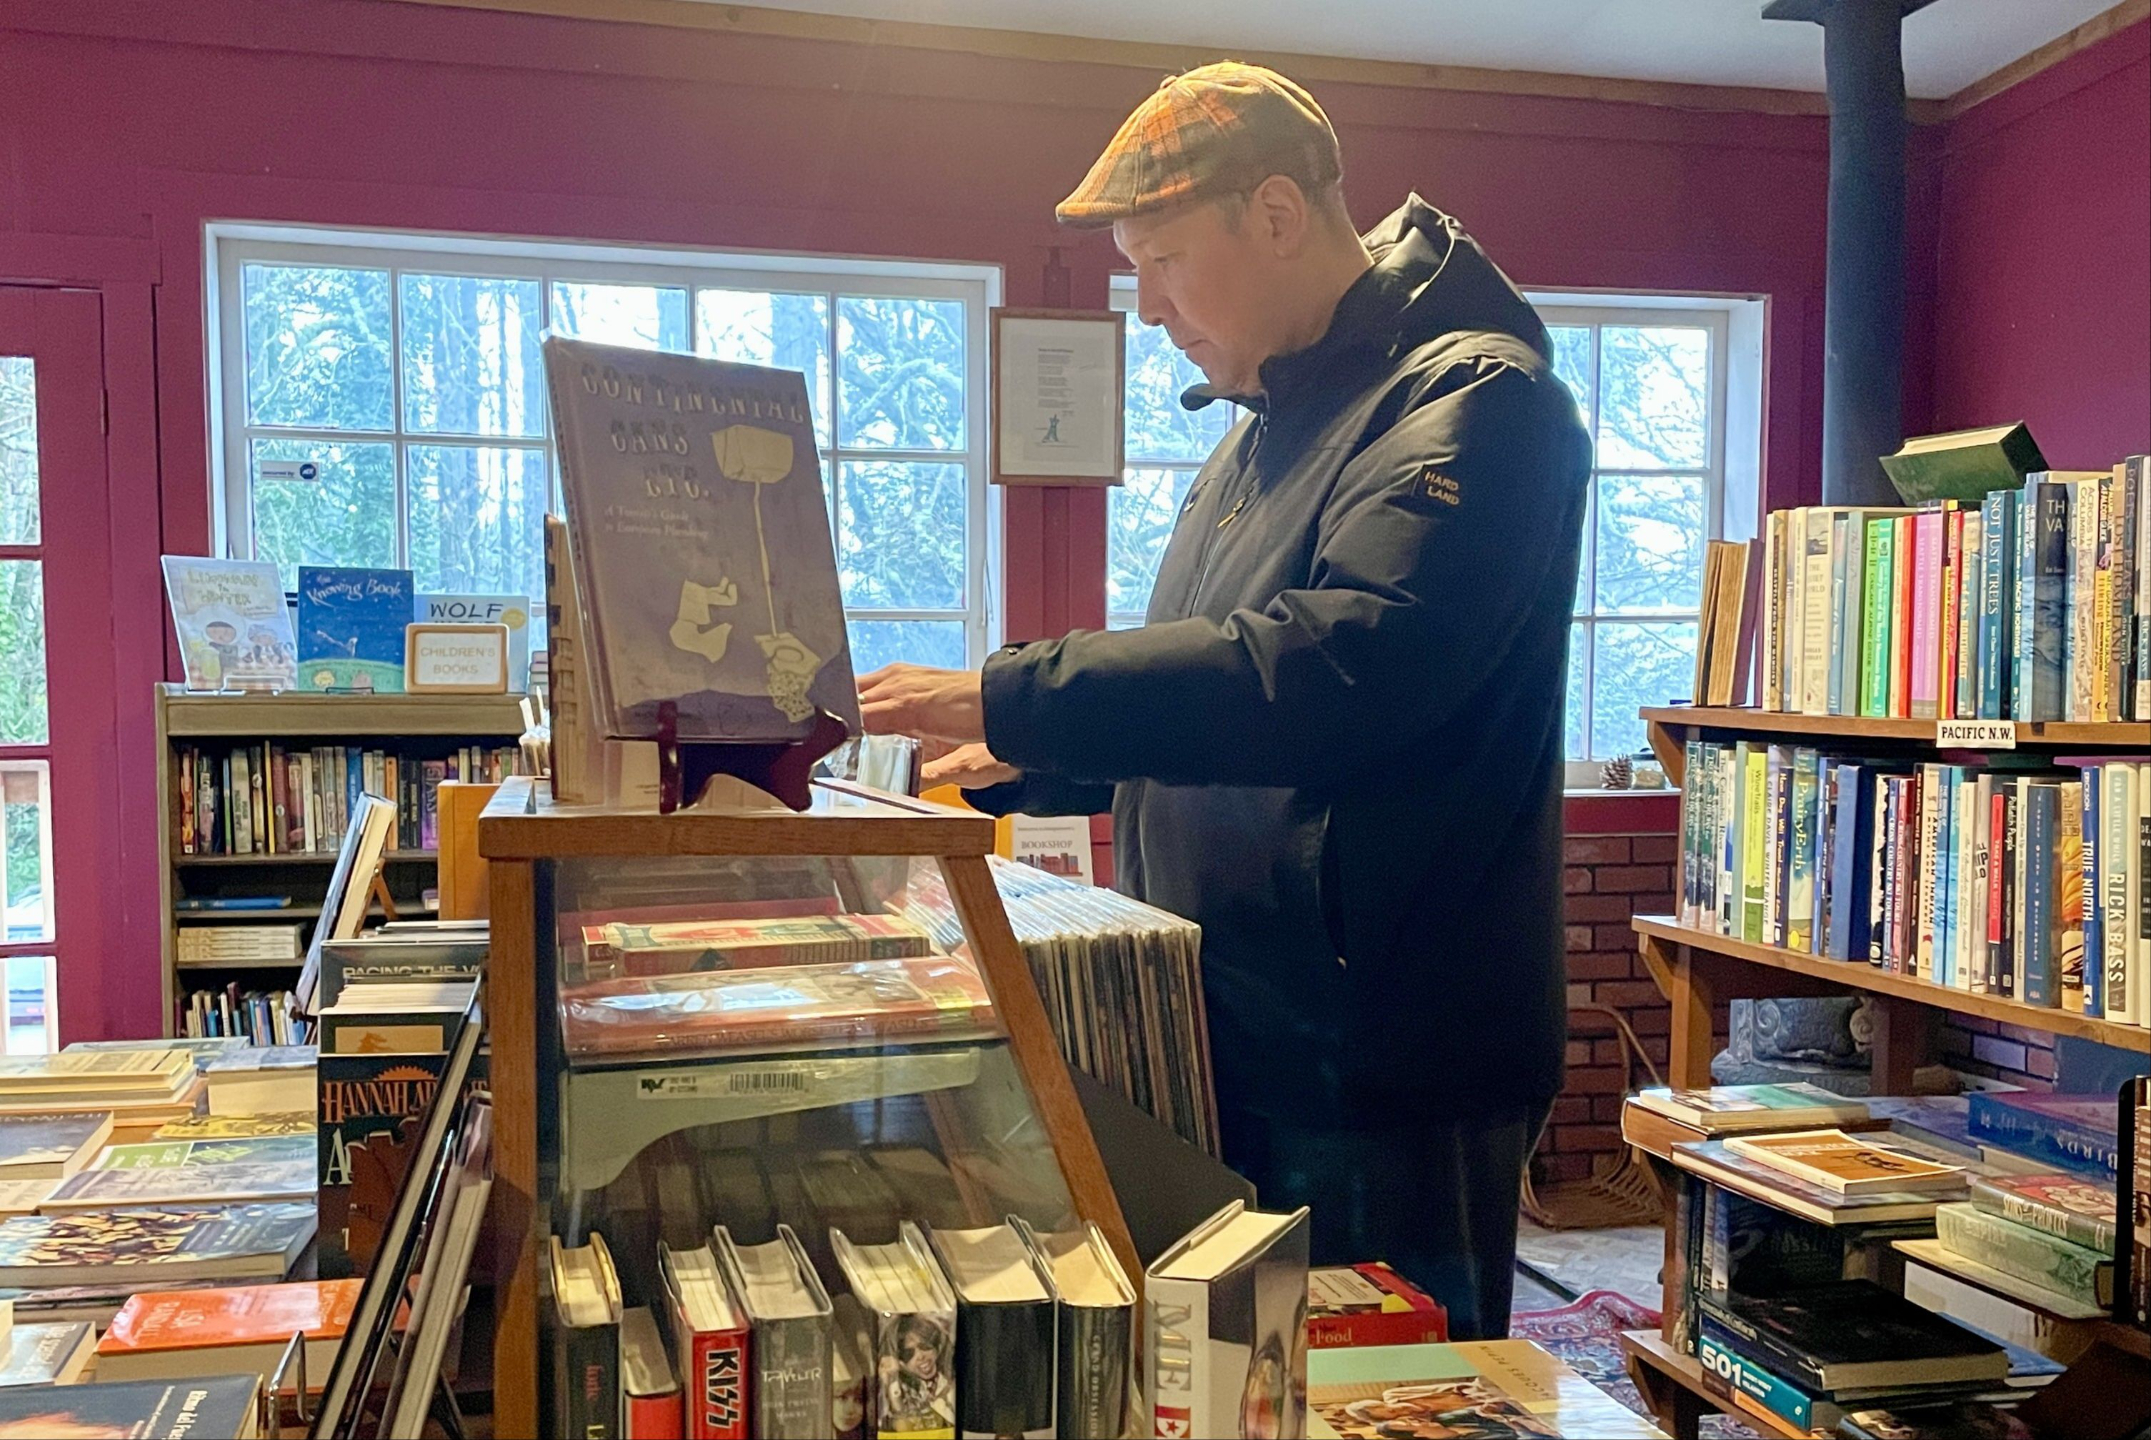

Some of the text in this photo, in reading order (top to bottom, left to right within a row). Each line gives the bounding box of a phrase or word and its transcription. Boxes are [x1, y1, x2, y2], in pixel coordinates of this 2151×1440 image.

[581, 362, 804, 423] CONTINENTAL
[610, 418, 689, 456] CANS
[643, 463, 711, 500] ETC.
[1425, 471, 1459, 491] HARD
[1427, 485, 1459, 505] LAND
[2078, 487, 2088, 546] COLUMBIA
[2086, 487, 2096, 534] ACROSS
[1918, 537, 1926, 572] SEATTLE
[1988, 497, 2002, 615] NOT JUST TREES
[2122, 468, 2136, 601] POETS PEAKS
[307, 578, 403, 608] Knowing Book
[430, 602, 504, 618] WOLF
[1915, 574, 1925, 640] TRANSFORMED
[1928, 537, 1938, 640] SEATTLE TRANSFORMED
[2111, 515, 2124, 663] LOST HOMELAND
[420, 646, 496, 658] CHILDREN'S
[433, 664, 479, 675] BOOKS
[1942, 727, 2012, 740] PACIFIC N.W.
[1719, 777, 1727, 821] Columbia
[1778, 797, 1786, 814] Dog
[1021, 840, 1073, 849] BOOKSHOP
[1718, 825, 1726, 850] River
[1778, 818, 1786, 834] Will
[1794, 781, 1809, 870] PrairyErth
[2005, 796, 2017, 851] Potlatch People
[1930, 816, 1938, 876] AMERICAN
[2083, 840, 2094, 921] TRUE NORTH
[2108, 873, 2125, 983] RICK BASS
[322, 1081, 408, 1124] HANNAH
[1316, 1327, 1352, 1344] Food
[1702, 1344, 1742, 1387] 501
[706, 1347, 742, 1430] KISS
